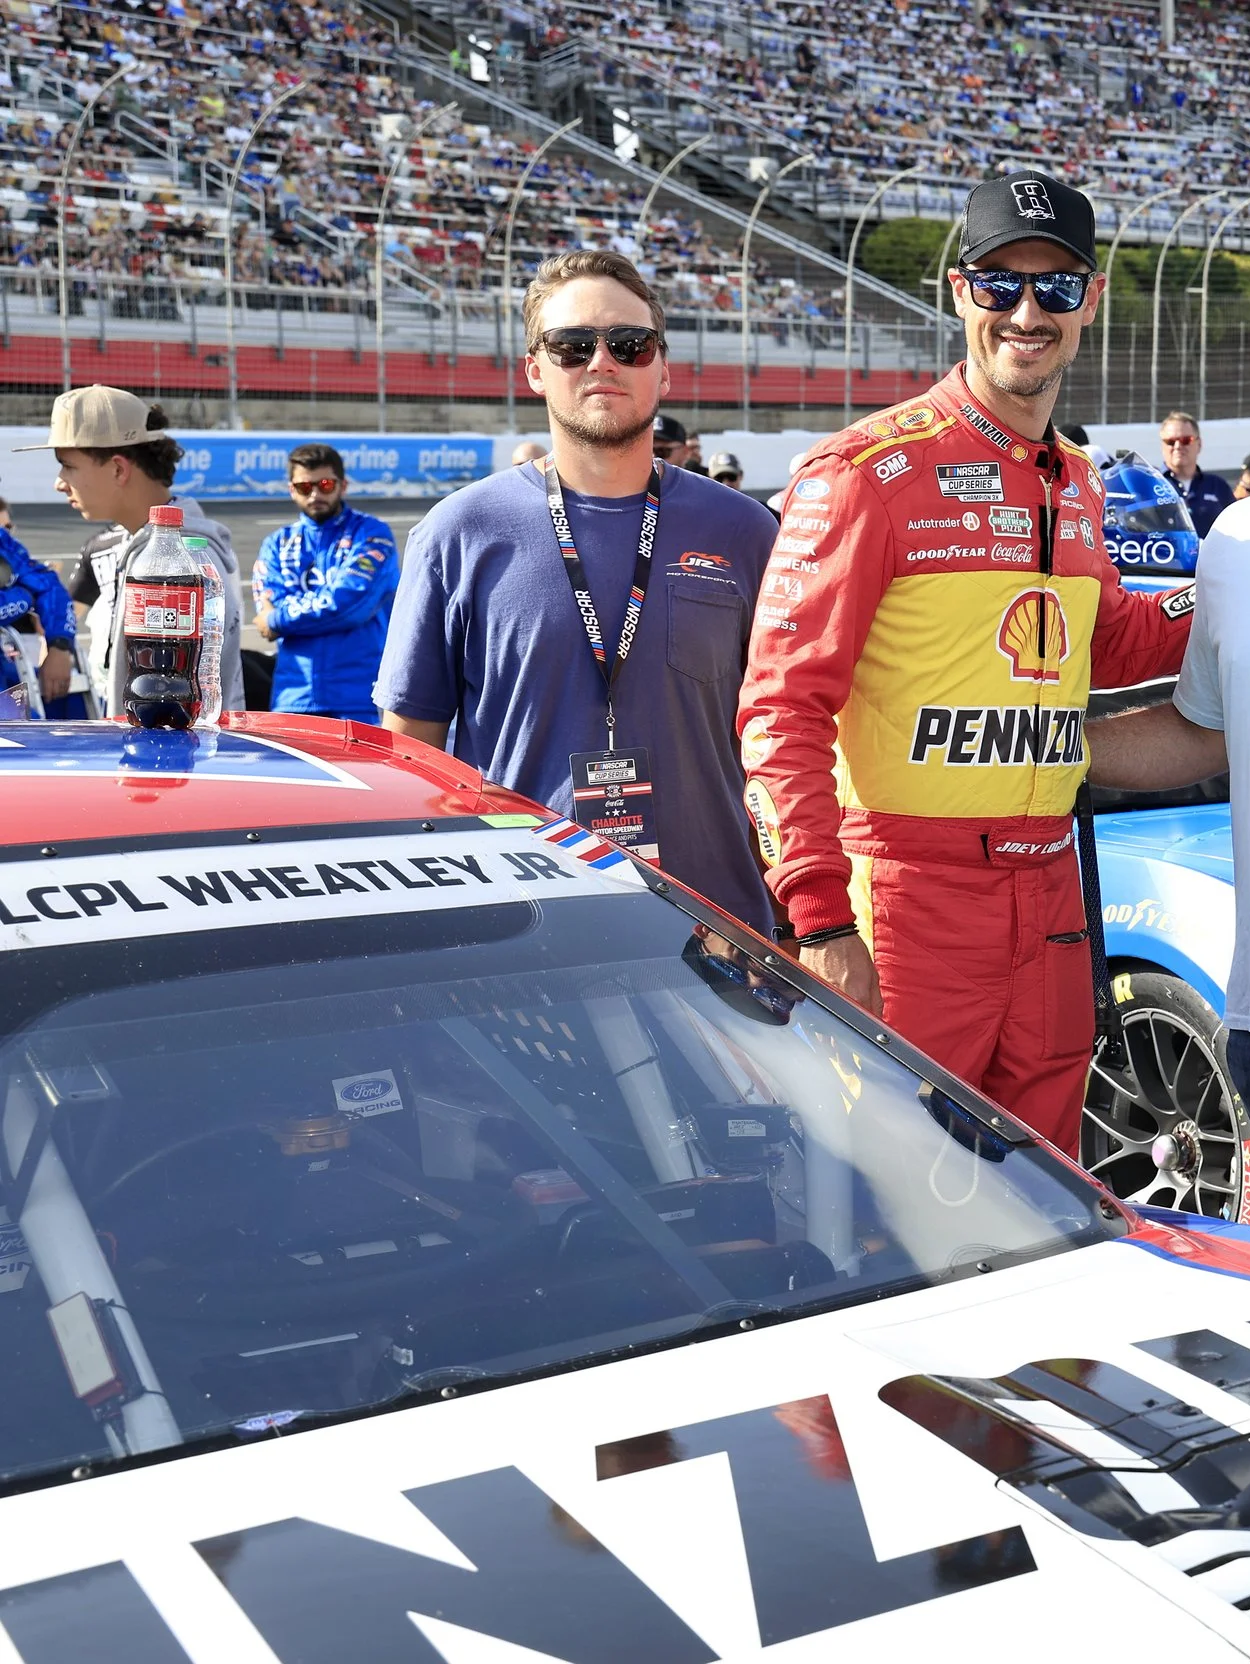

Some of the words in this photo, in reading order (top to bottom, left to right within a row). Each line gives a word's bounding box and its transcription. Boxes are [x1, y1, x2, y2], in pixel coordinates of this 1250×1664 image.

[901, 411, 928, 428] PENNZOIL
[959, 403, 1013, 450] PENNZOIL
[234, 443, 287, 475] prim
[419, 443, 477, 475] prime
[876, 454, 908, 480] OMP
[956, 465, 990, 477] NASCAR
[948, 481, 965, 490] CUP
[965, 479, 993, 489] SERIES
[547, 495, 574, 542] NASCAR
[991, 517, 1029, 527] BROTHERS
[999, 510, 1020, 519] HUNT
[907, 516, 961, 531] Autotrader
[1001, 524, 1023, 533] PIZZA
[637, 506, 659, 559] NASCAR
[907, 543, 986, 562] GOODYEAR
[1102, 540, 1175, 564] eero
[685, 557, 716, 568] JR
[666, 571, 737, 585] MOTORSPORTS
[1172, 595, 1190, 610] sfi
[574, 590, 603, 644] NASCAR
[617, 603, 641, 660] NASCAR
[908, 706, 1087, 767] PENNZOIL
[602, 761, 628, 770] NASCAR
[608, 771, 630, 779] SERIES
[591, 815, 643, 829] CHARLOTTE
[614, 824, 645, 834] SPEEDWAY
[748, 792, 776, 858] PENNZOIL
[995, 841, 1042, 855] JOEY
[0, 880, 166, 925] LCPL
[158, 854, 494, 908] WHEATLEY
[499, 851, 576, 882] JR
[353, 1083, 383, 1099] Ford
[350, 1100, 401, 1114] ACING
